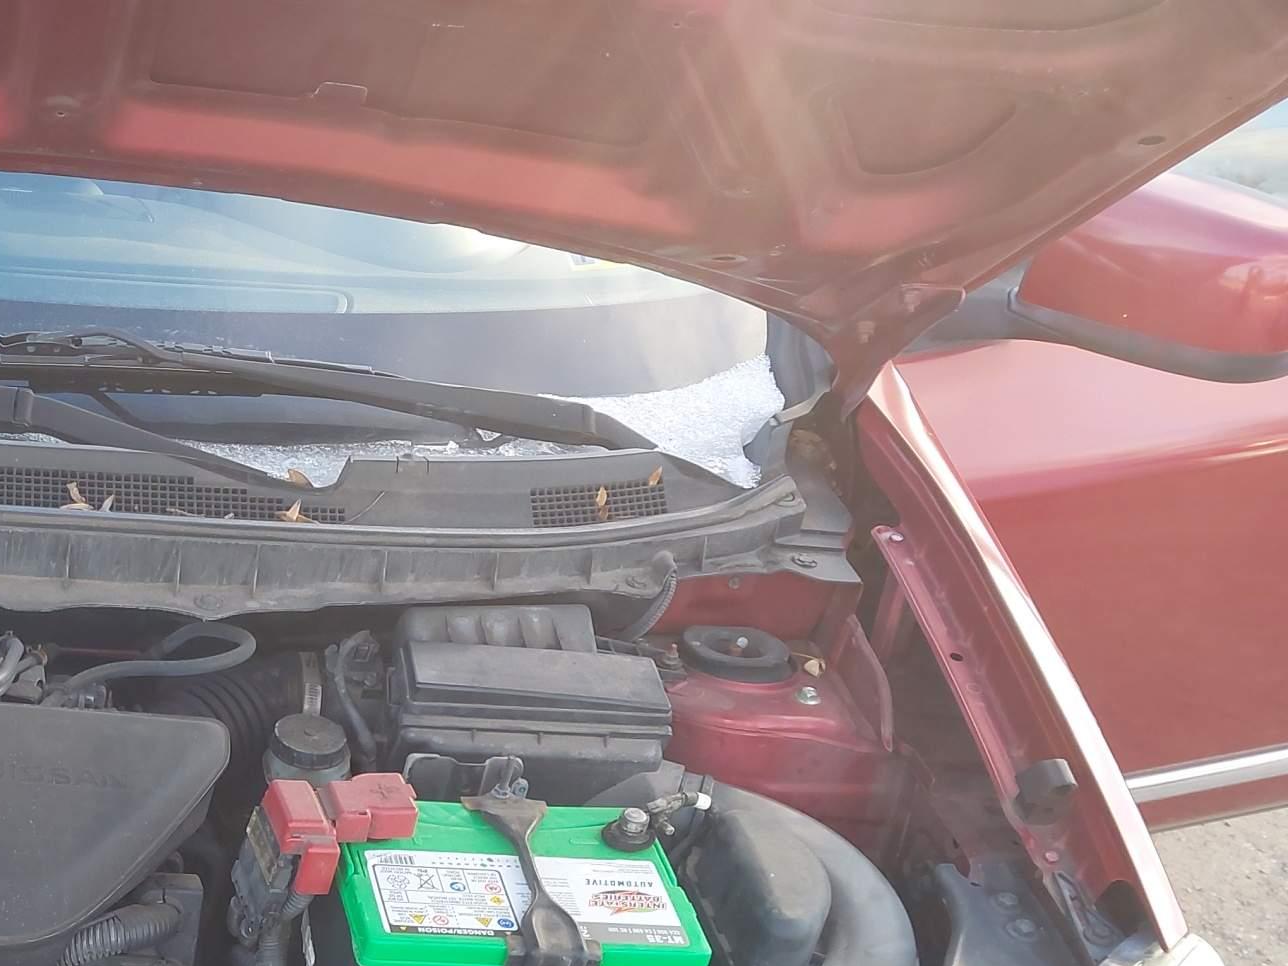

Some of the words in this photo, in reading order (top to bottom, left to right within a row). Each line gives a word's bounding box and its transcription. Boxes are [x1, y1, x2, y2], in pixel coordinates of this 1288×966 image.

[585, 879, 653, 888] AUTOMOTIVE
[592, 894, 661, 902] BATTERIES
[590, 900, 666, 909] INTERSTATE
[418, 926, 495, 936] DANGER/POISON
[647, 934, 685, 944] MT-35
